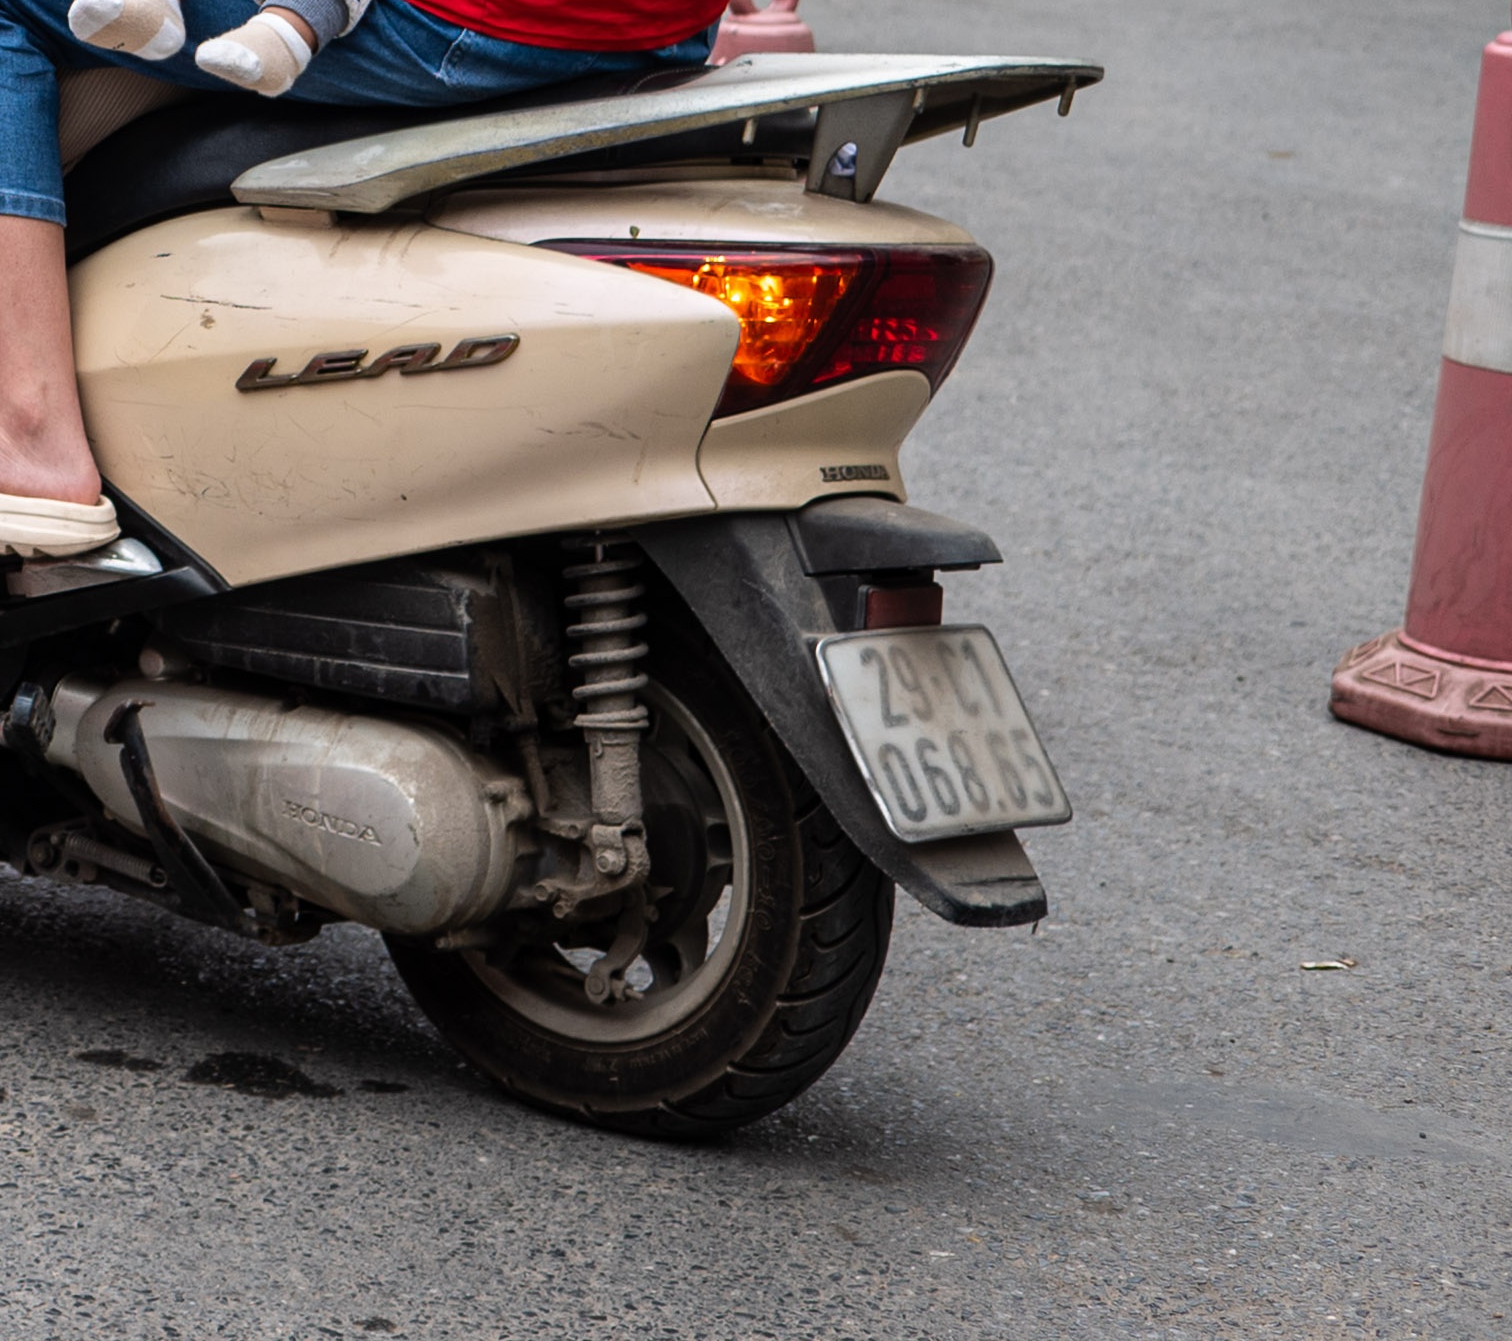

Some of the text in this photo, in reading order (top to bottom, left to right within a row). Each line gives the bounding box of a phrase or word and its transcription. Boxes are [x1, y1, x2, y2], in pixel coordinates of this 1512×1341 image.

[236, 332, 520, 392] LEAD
[821, 463, 891, 483] HONDA
[279, 797, 383, 848] HONDA
